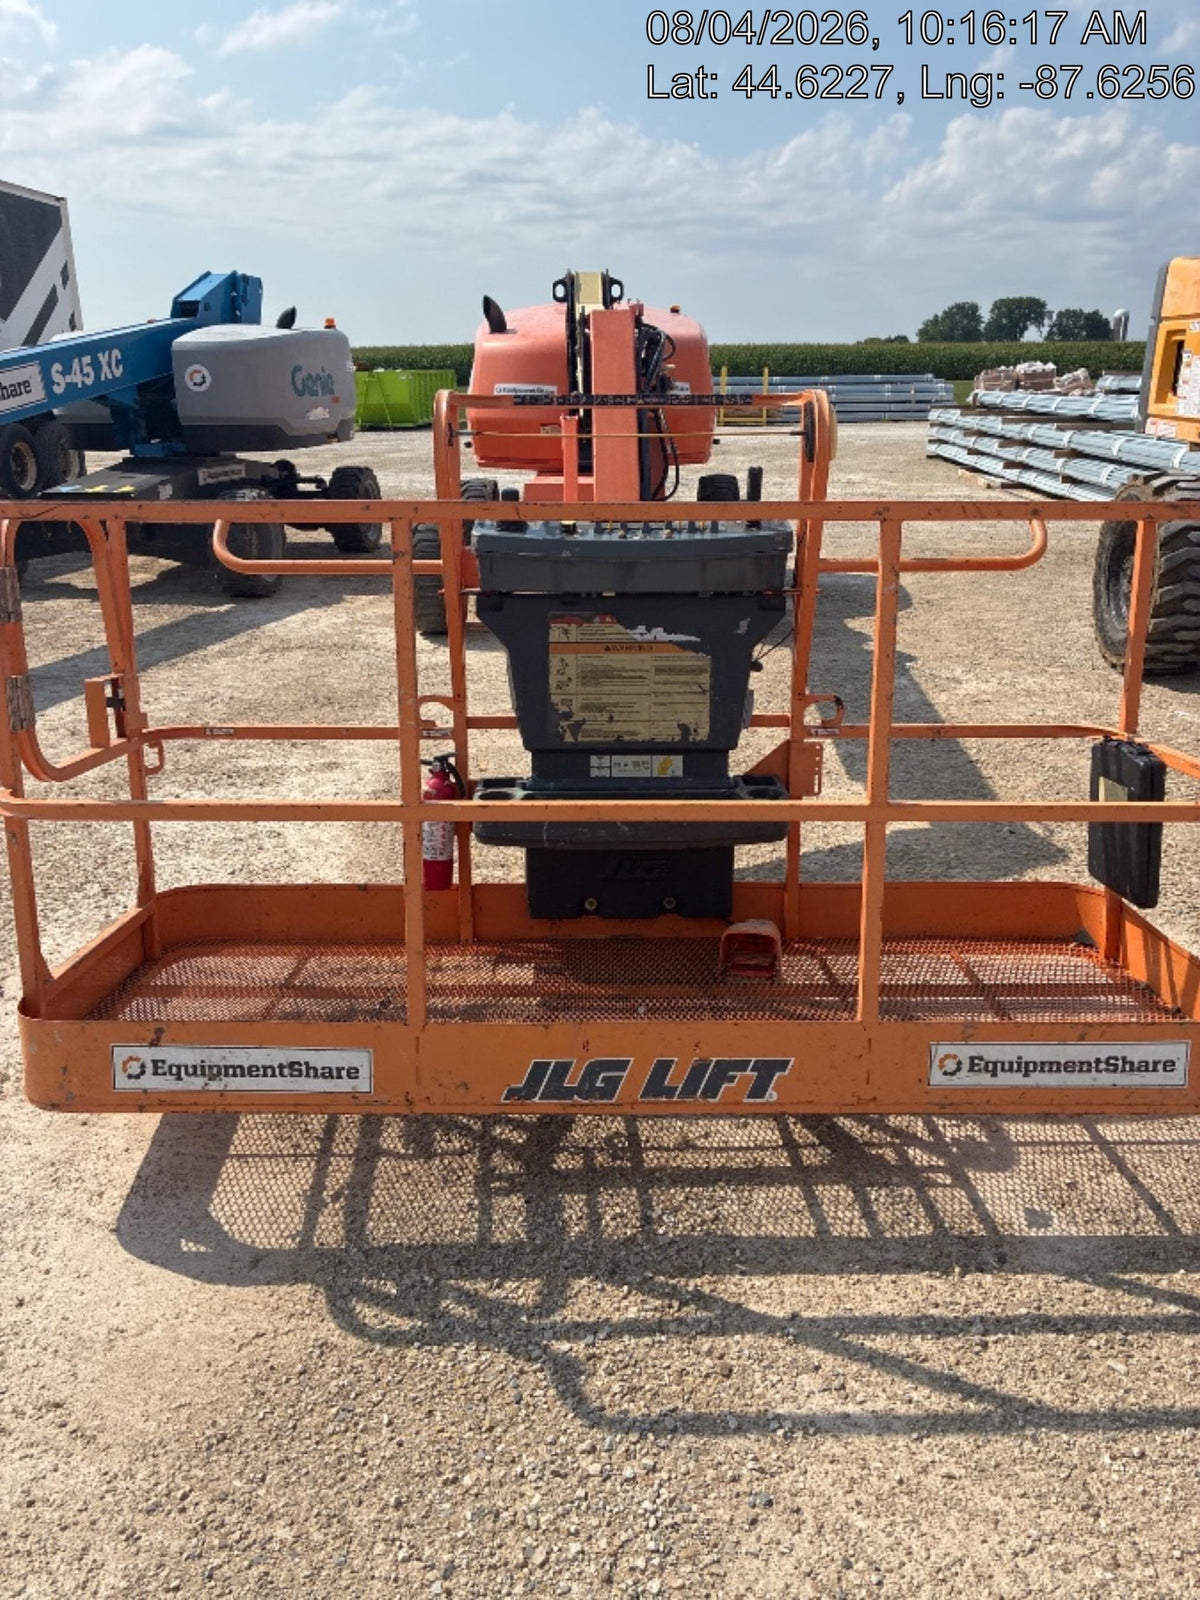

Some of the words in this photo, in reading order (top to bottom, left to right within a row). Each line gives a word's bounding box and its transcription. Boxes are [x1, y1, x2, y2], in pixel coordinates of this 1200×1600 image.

[51, 357, 95, 394] S-45
[97, 348, 123, 381] XC
[291, 364, 335, 397] Genie
[151, 1058, 360, 1081] EquipmentShare
[501, 1058, 634, 1102] JLG
[638, 1057, 795, 1102] LIFT
[967, 1056, 1177, 1078] EquipmentShare
